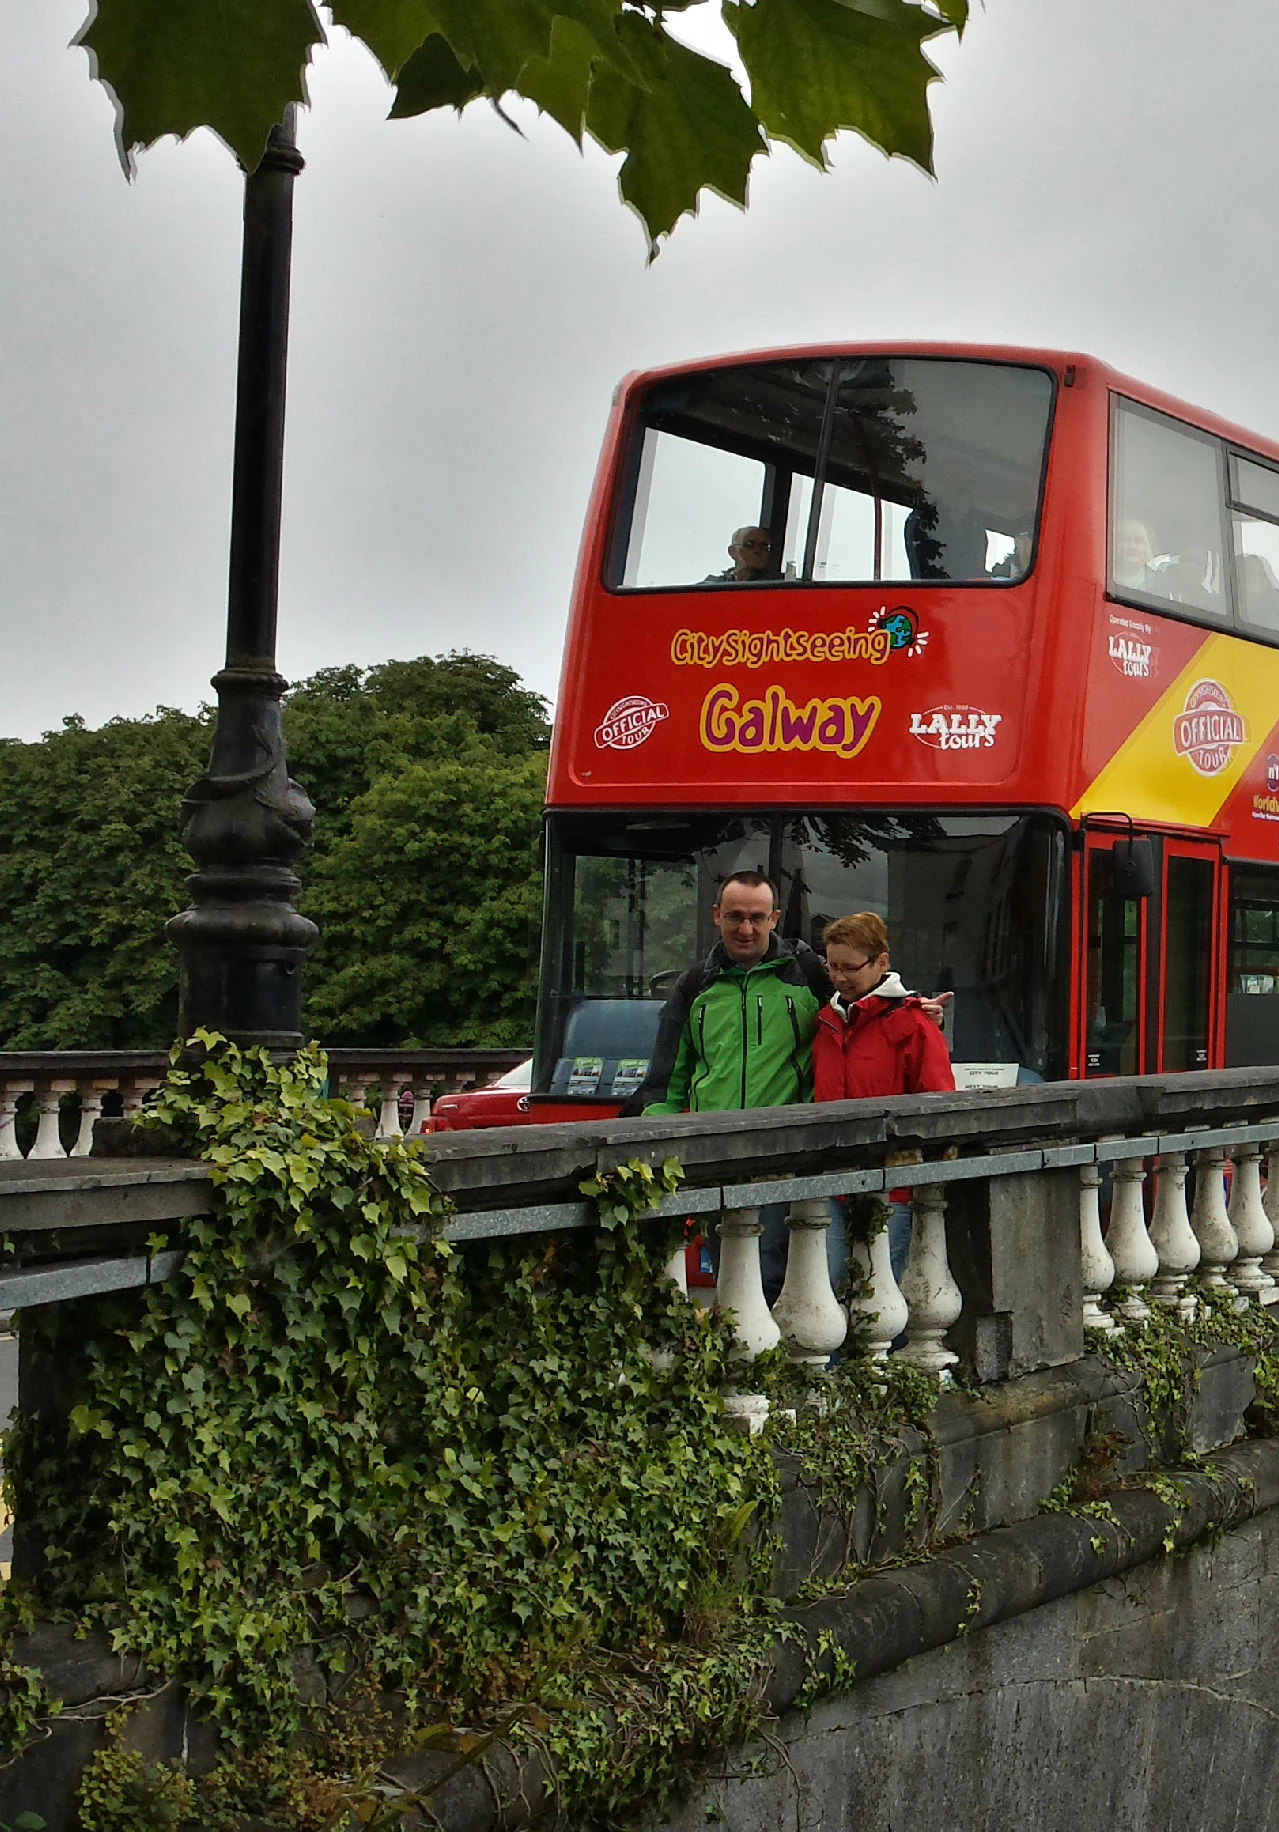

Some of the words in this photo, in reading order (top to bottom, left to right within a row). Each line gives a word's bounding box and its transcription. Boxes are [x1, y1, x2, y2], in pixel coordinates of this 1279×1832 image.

[1108, 636, 1152, 664] LALLY
[602, 706, 665, 742] OFFICIAL
[700, 682, 882, 760] Galway
[908, 713, 1003, 735] LALLY
[1180, 714, 1241, 748] OFFICIAL
[621, 725, 650, 745] TOUR
[938, 728, 995, 750] tours
[1199, 746, 1227, 769] TOUR
